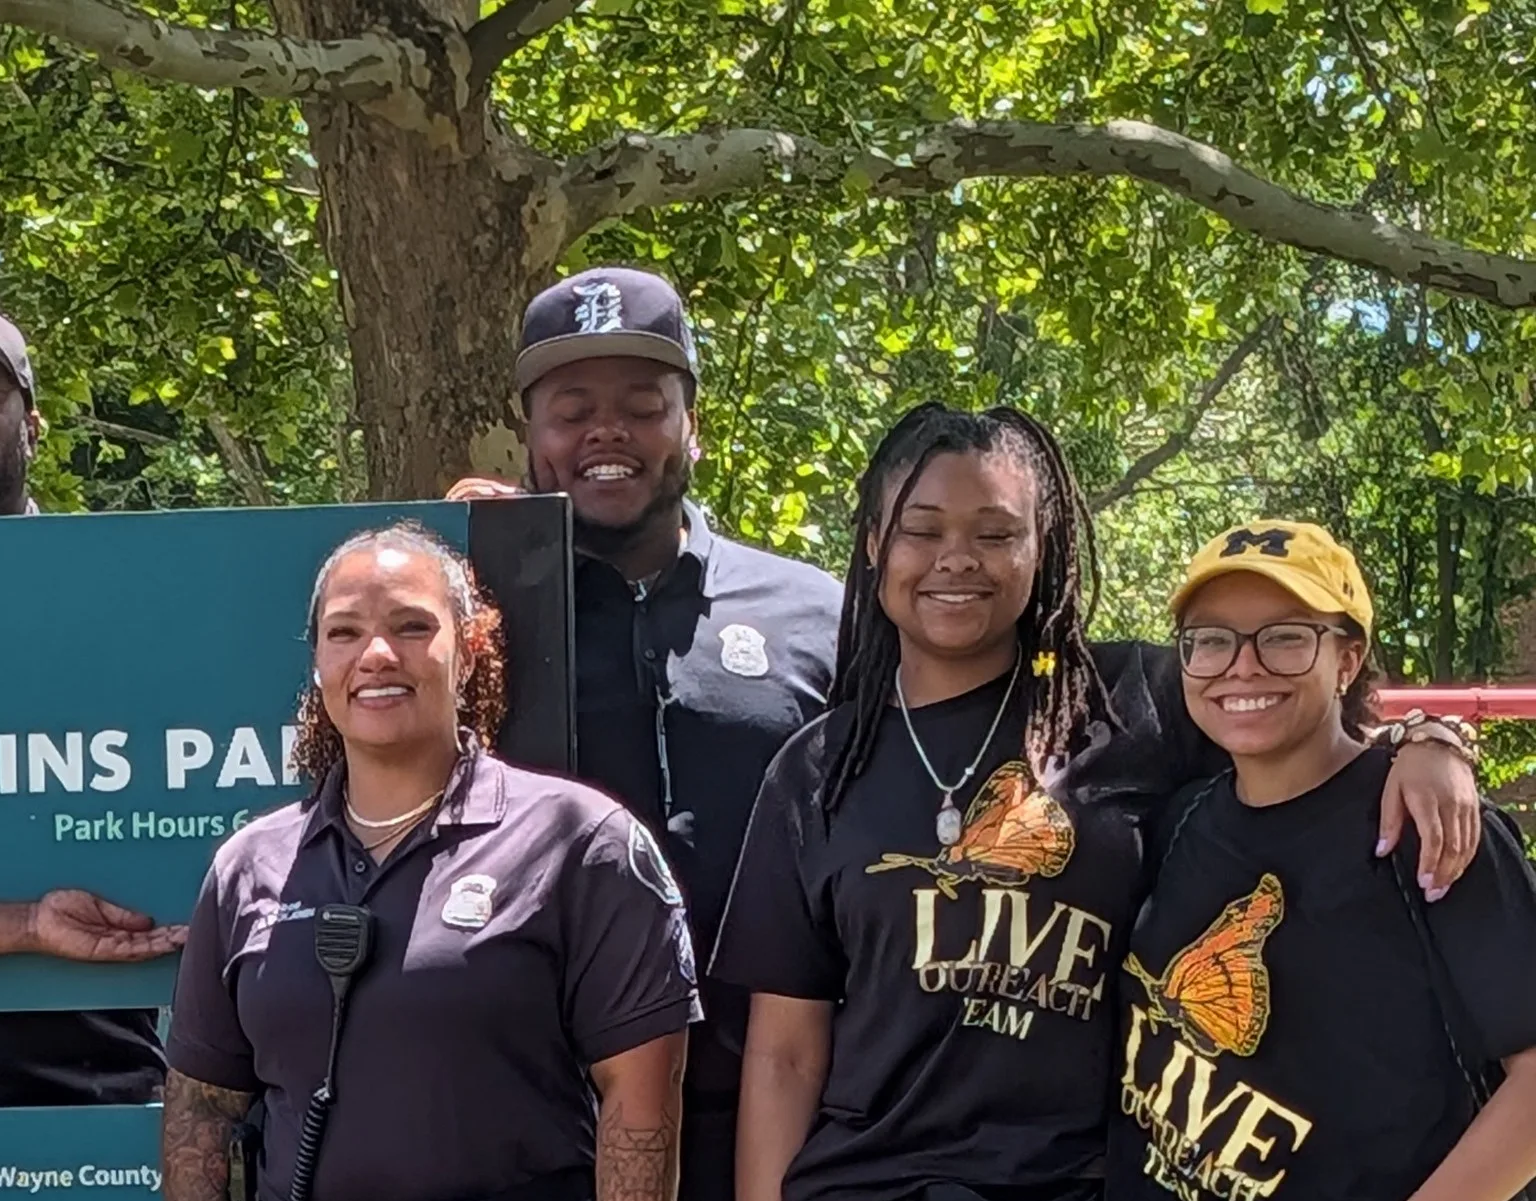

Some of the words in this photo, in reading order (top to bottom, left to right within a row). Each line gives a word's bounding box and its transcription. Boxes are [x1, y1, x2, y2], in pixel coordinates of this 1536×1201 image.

[1219, 528, 1296, 558] M
[54, 811, 125, 842] Park
[132, 811, 225, 839] Hours
[912, 888, 1111, 1001] LIVE
[962, 997, 1034, 1040] EAM
[1120, 1003, 1313, 1199] LIVE
[78, 1165, 162, 1192] County
